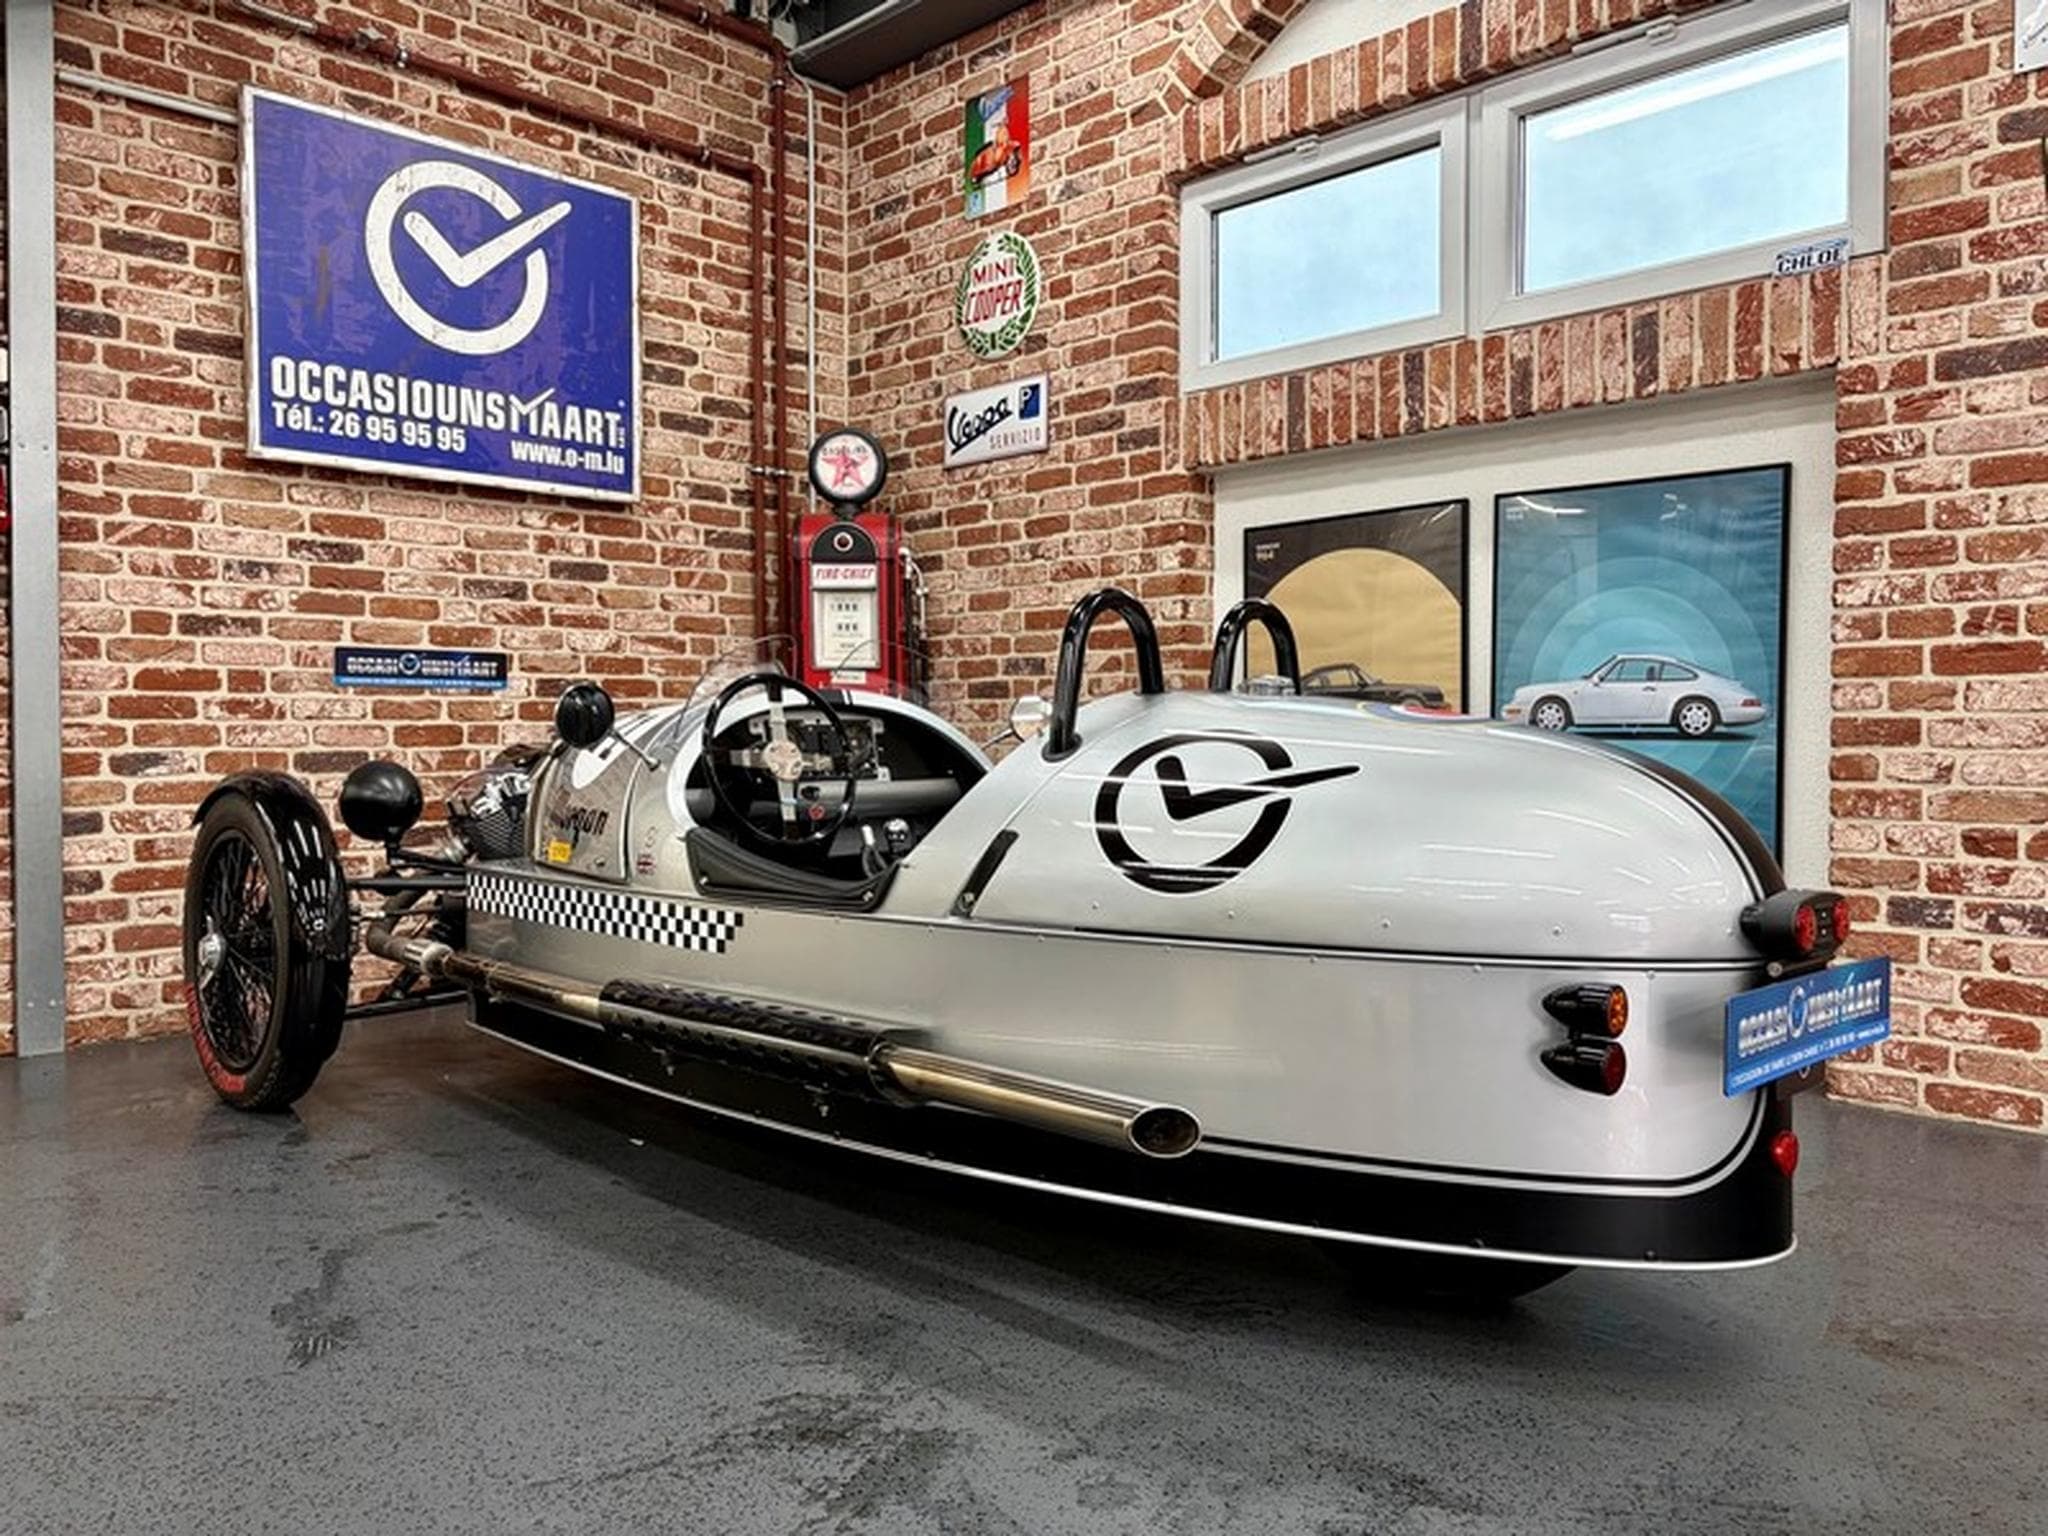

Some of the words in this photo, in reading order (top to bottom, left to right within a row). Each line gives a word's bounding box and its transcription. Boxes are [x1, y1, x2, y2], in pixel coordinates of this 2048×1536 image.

[973, 257, 1014, 285] MINI
[271, 401, 324, 433] Tél.:
[329, 410, 361, 438] 26
[365, 415, 398, 443] 95
[401, 420, 432, 448] 95
[436, 425, 467, 453] 95
[947, 397, 1014, 456] Vespa
[510, 440, 626, 475] www.o-m.lu
